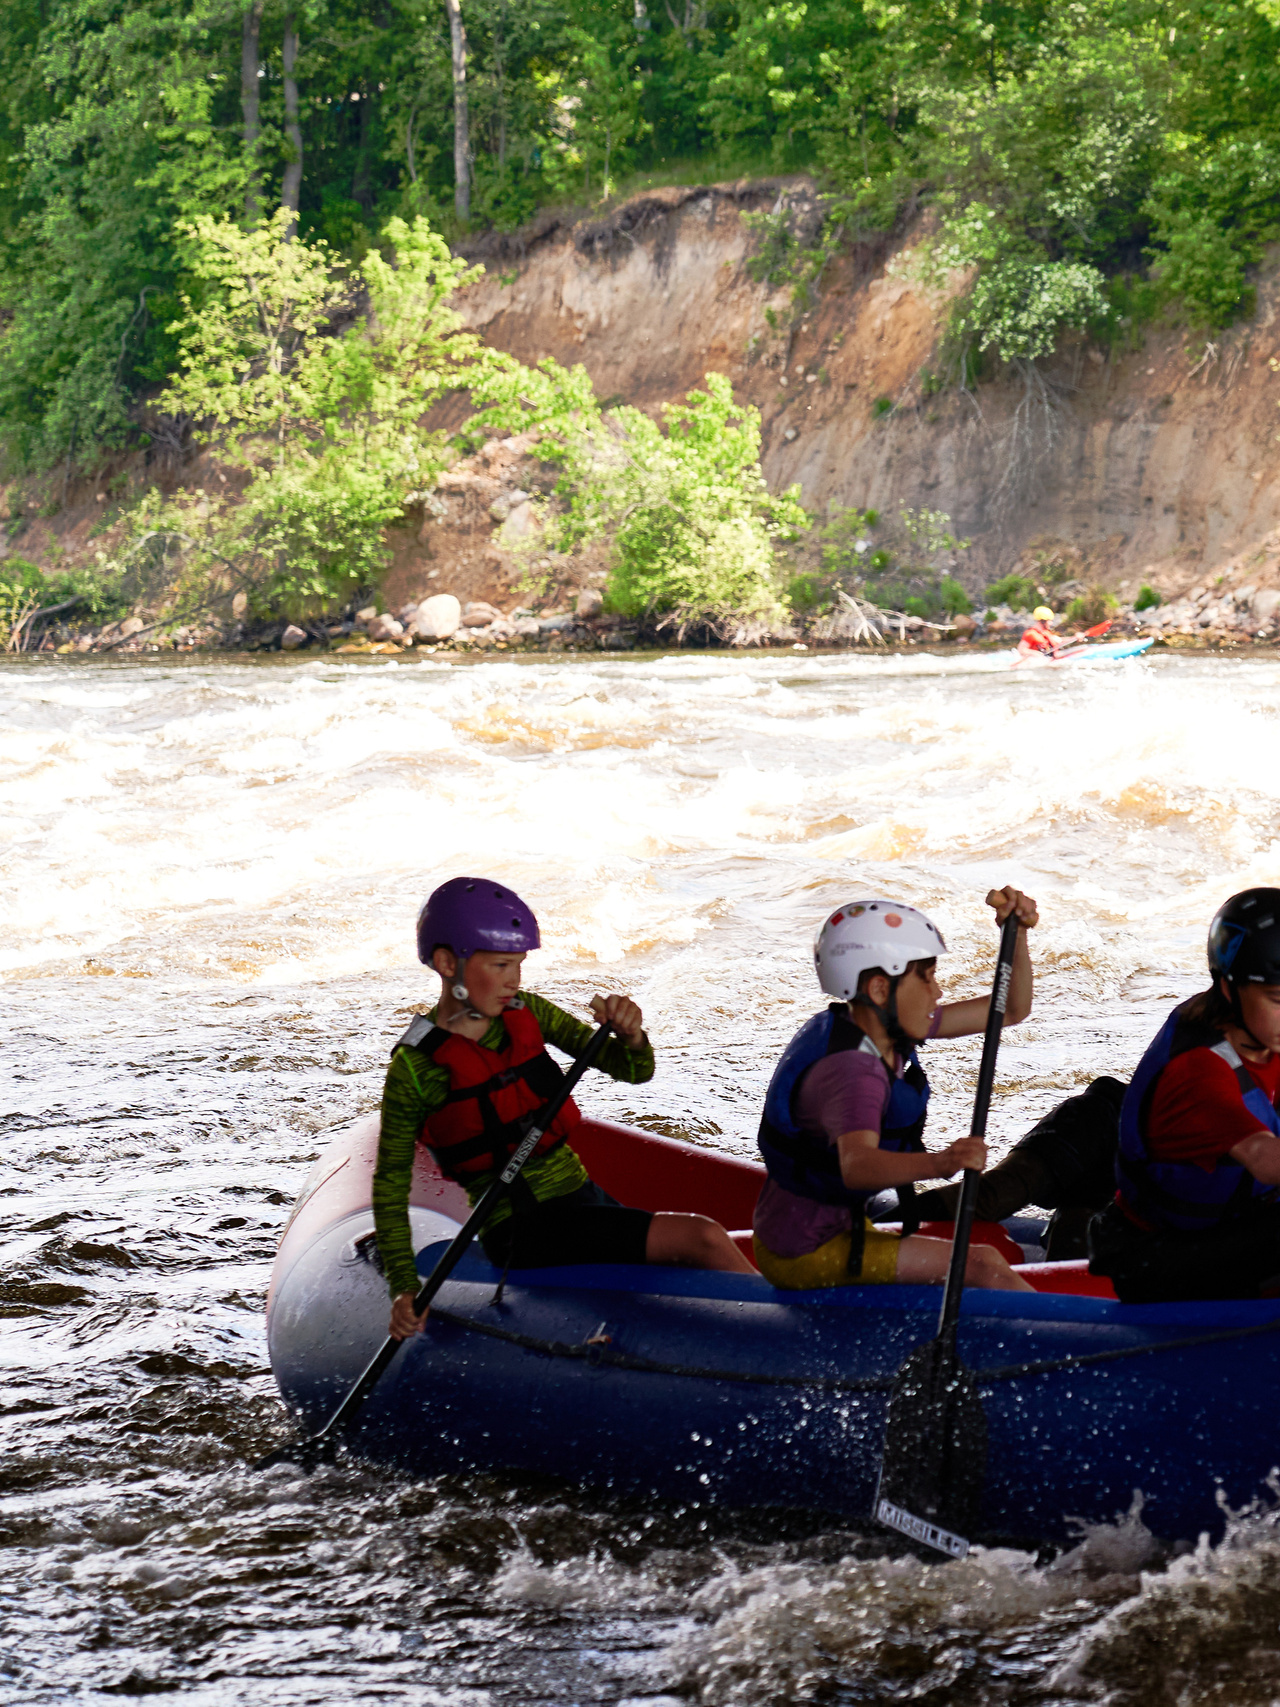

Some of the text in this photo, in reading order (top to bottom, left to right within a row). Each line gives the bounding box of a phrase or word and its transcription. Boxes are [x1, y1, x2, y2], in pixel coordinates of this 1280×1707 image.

[995, 962, 1012, 1014] ДАНИИЛ
[508, 1128, 541, 1171] MISSILE
[884, 1504, 949, 1551] MISSILE
